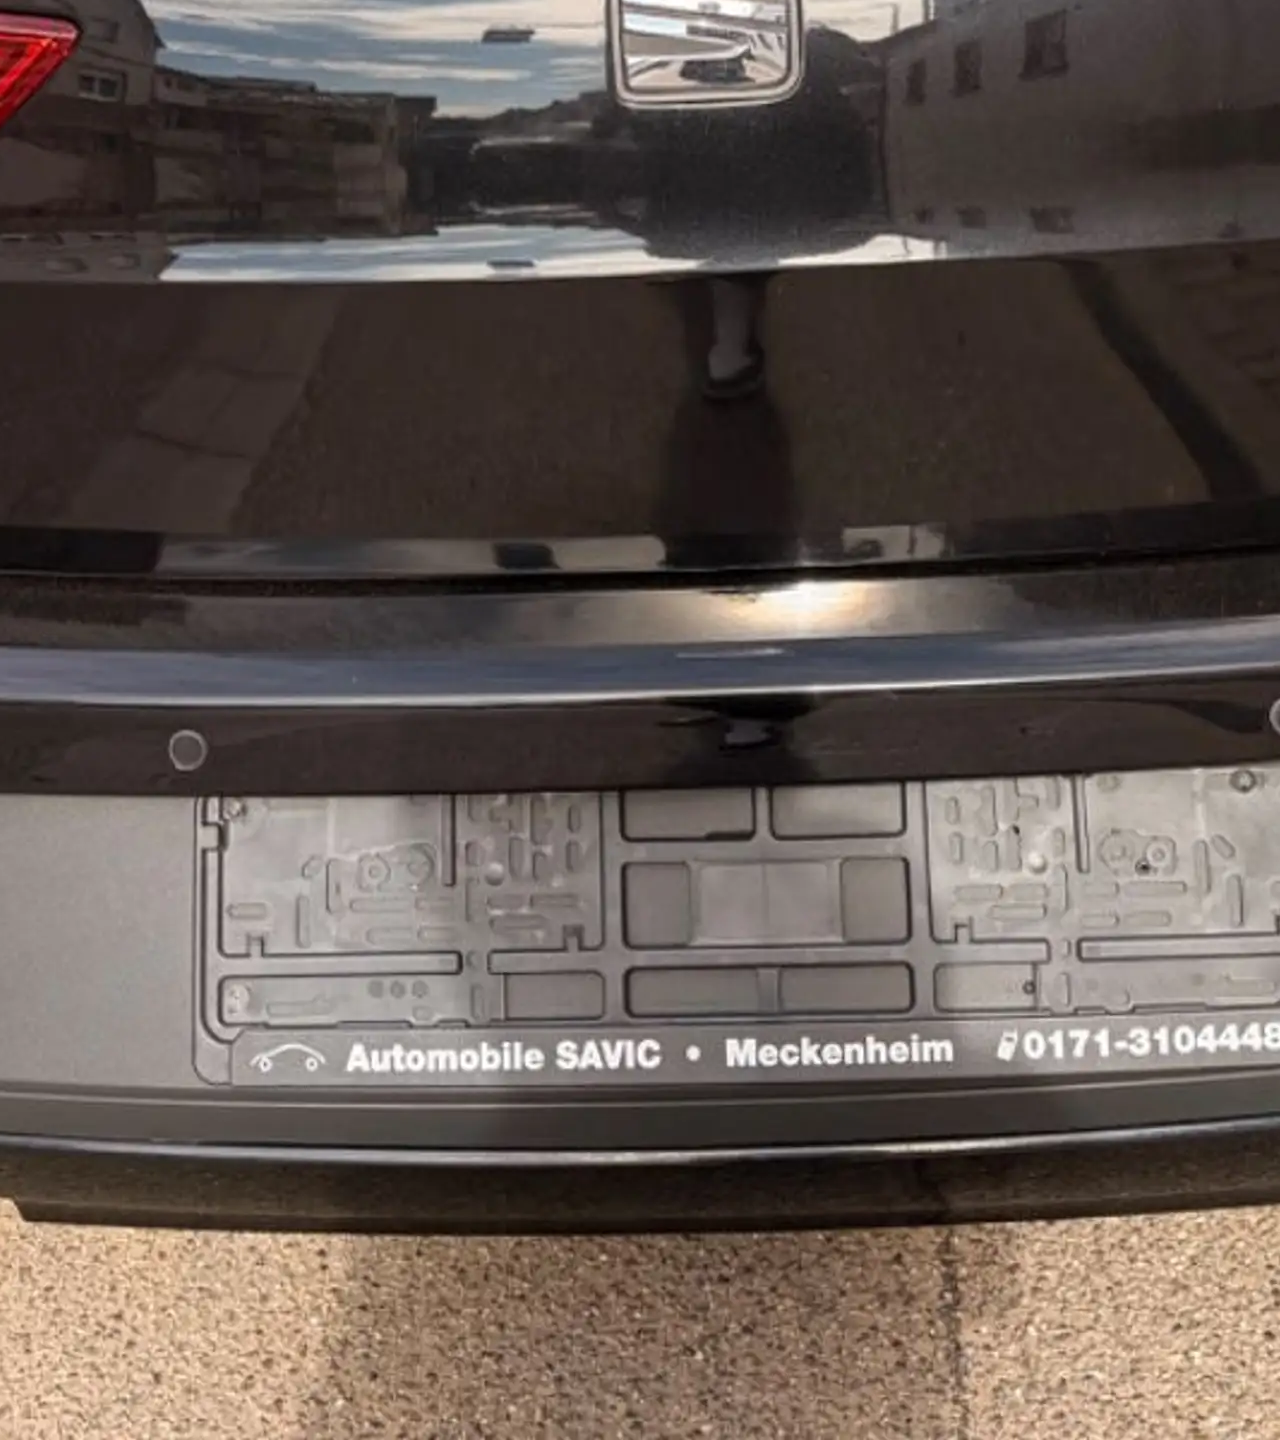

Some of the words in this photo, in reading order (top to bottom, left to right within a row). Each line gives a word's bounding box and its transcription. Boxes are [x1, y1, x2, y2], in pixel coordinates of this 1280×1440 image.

[346, 1043, 545, 1073] Automobile
[555, 1039, 662, 1069] SAVIC
[725, 1034, 954, 1068] Meckenheim
